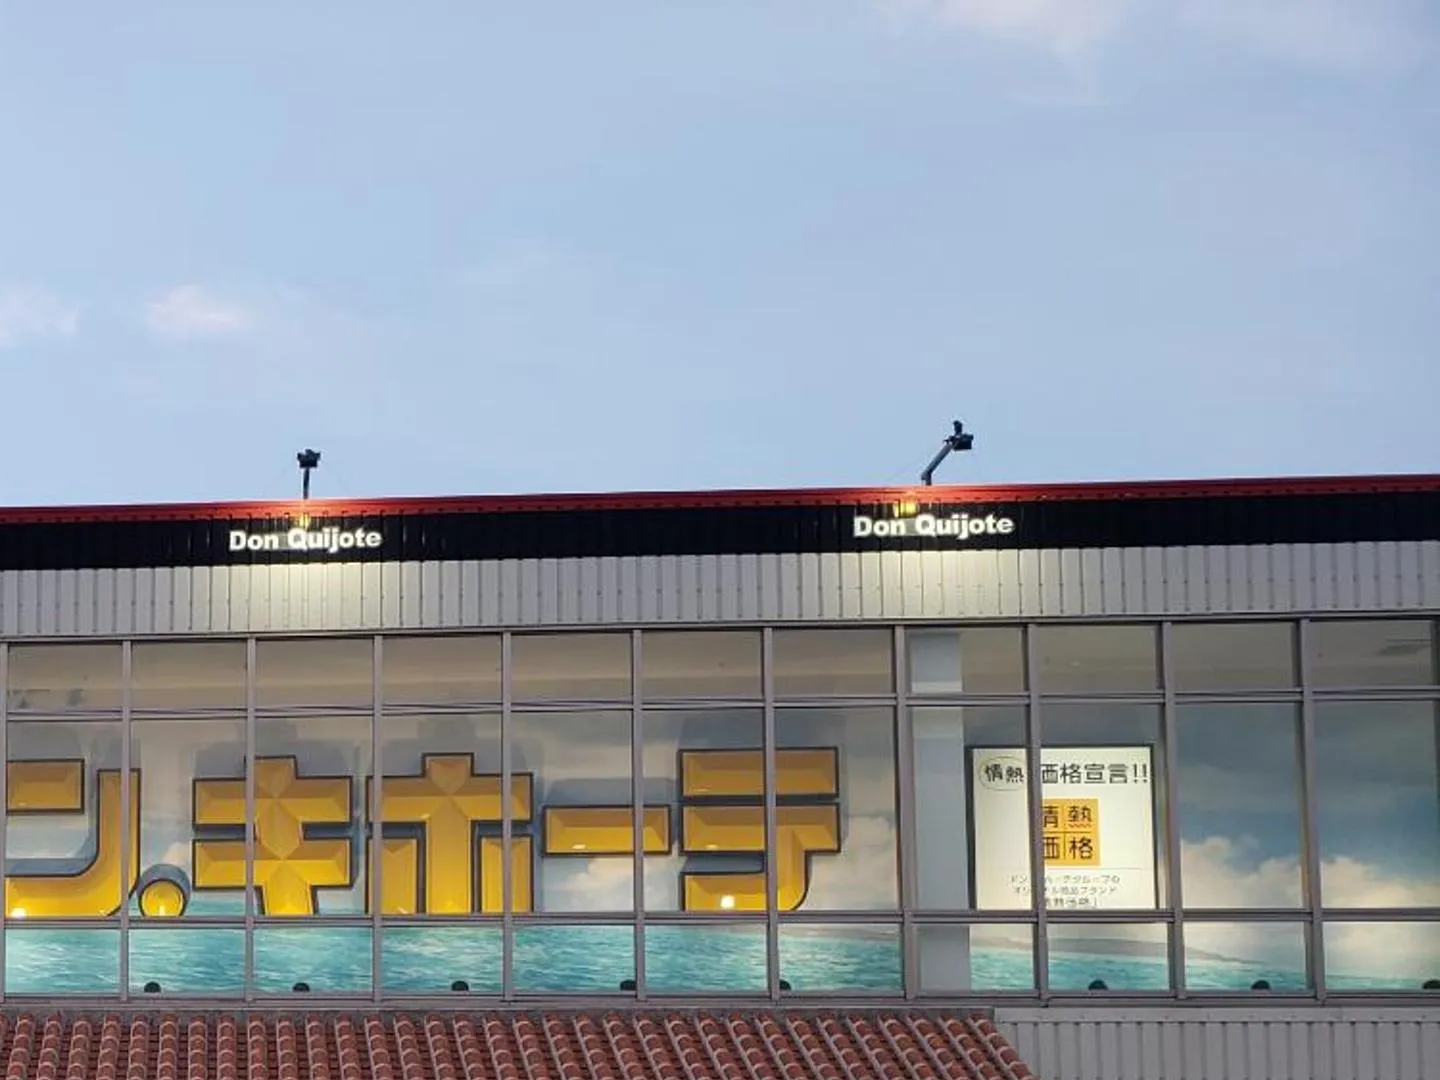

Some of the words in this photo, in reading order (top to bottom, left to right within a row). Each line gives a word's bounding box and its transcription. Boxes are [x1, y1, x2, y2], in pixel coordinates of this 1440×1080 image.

[229, 531, 279, 550] Don
[288, 527, 382, 553] Quijote
[854, 517, 906, 537] Don
[915, 514, 1014, 540] Quijote
